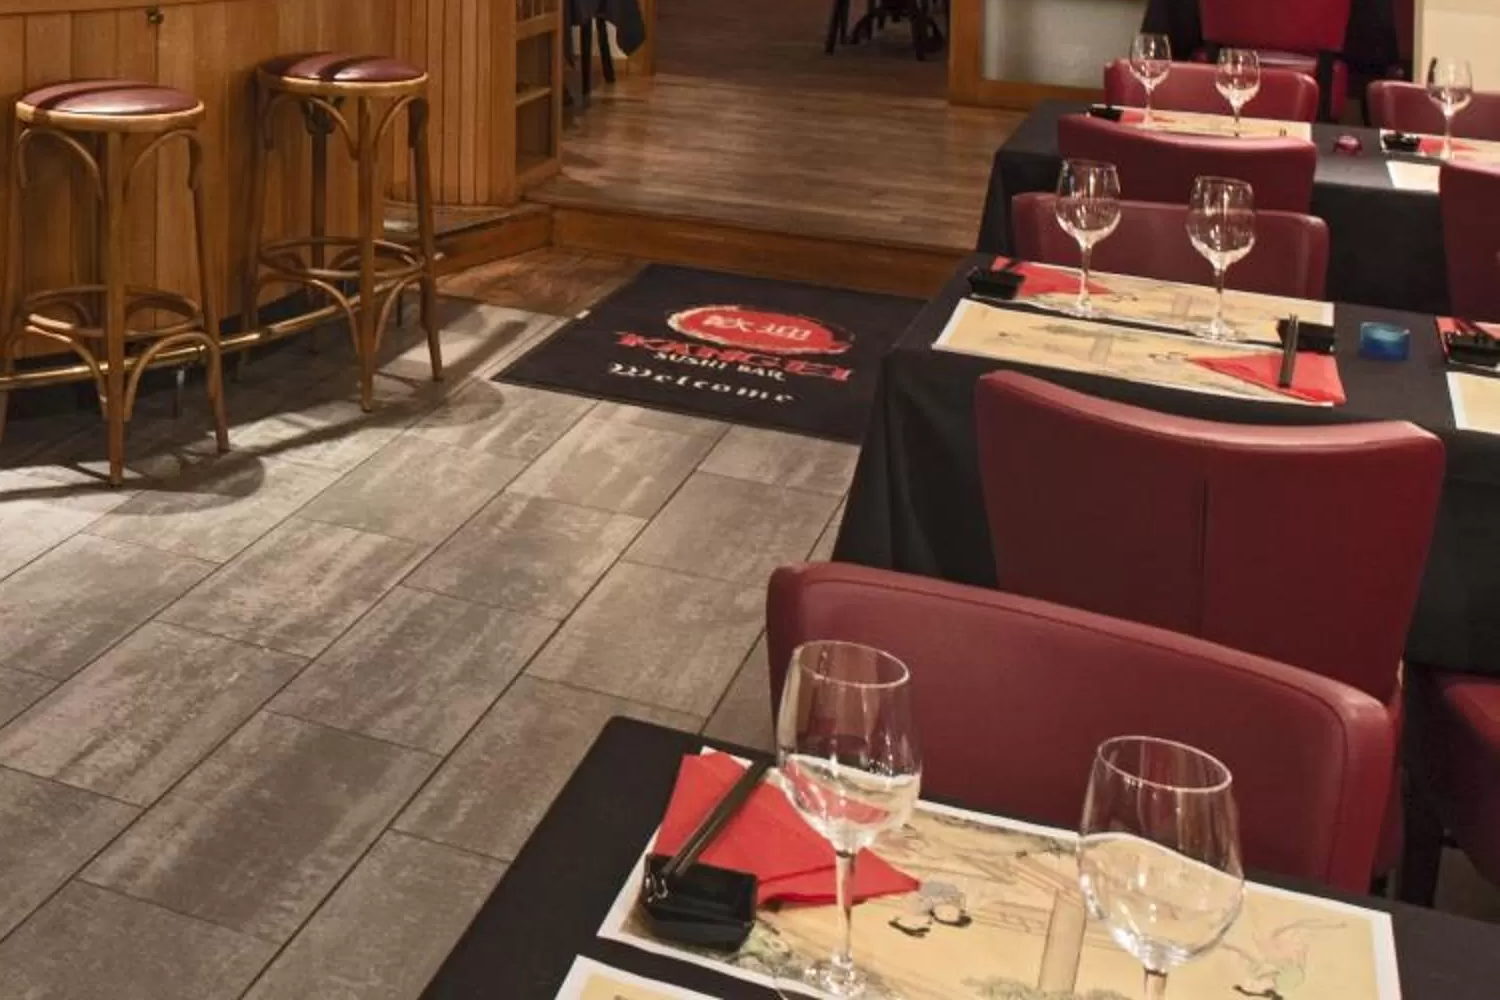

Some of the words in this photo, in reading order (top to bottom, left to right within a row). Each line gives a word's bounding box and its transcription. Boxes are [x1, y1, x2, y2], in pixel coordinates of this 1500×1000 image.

[608, 362, 795, 402] Welcome
[653, 351, 729, 370] SUSHI
[737, 364, 788, 382] BAR
